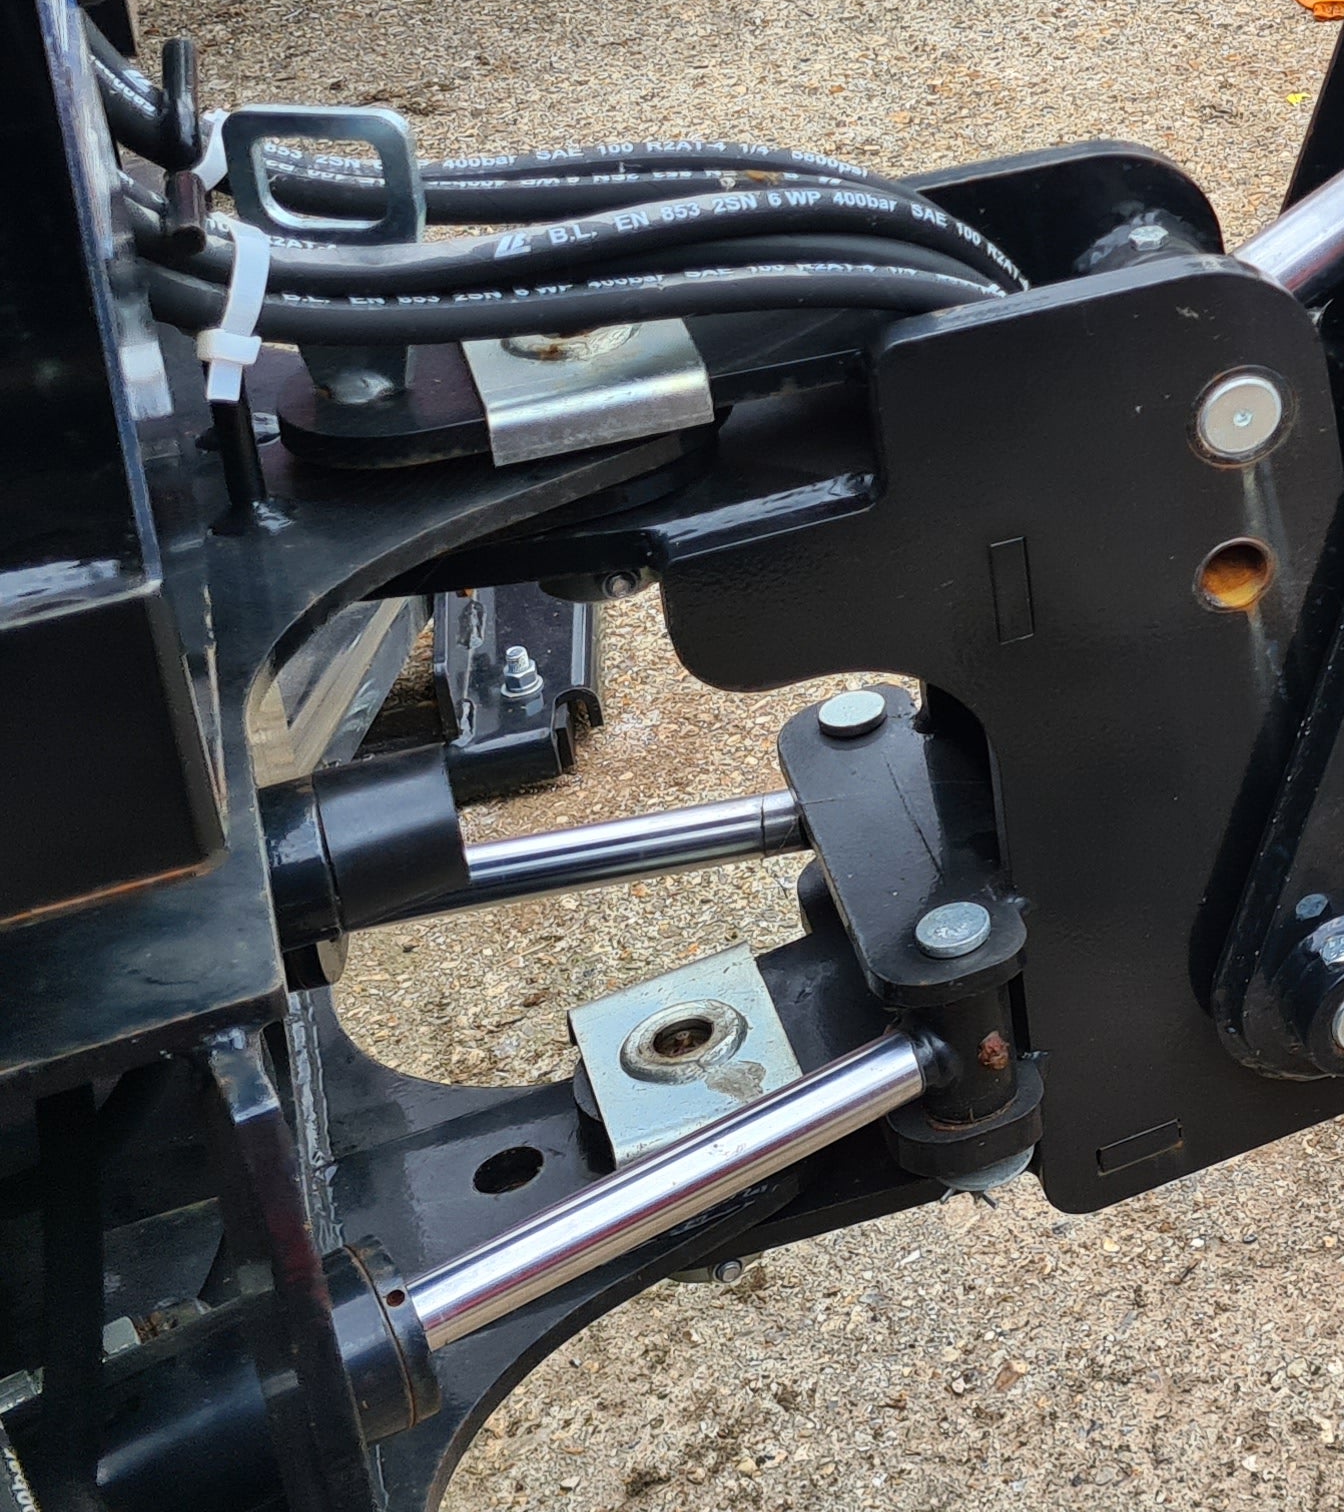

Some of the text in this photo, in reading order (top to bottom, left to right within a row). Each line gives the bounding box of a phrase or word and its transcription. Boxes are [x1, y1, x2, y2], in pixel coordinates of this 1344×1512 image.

[442, 154, 519, 171] 400bar
[535, 144, 585, 162] SAE
[599, 141, 635, 156] 100
[548, 223, 599, 246] B.L.
[614, 209, 651, 233] EN
[660, 201, 702, 223] 853
[711, 193, 758, 216] 2SN
[767, 191, 783, 208] 6
[784, 190, 822, 206] WP
[832, 190, 899, 213] 400bar
[910, 202, 948, 228] SAE
[955, 220, 982, 247] 100
